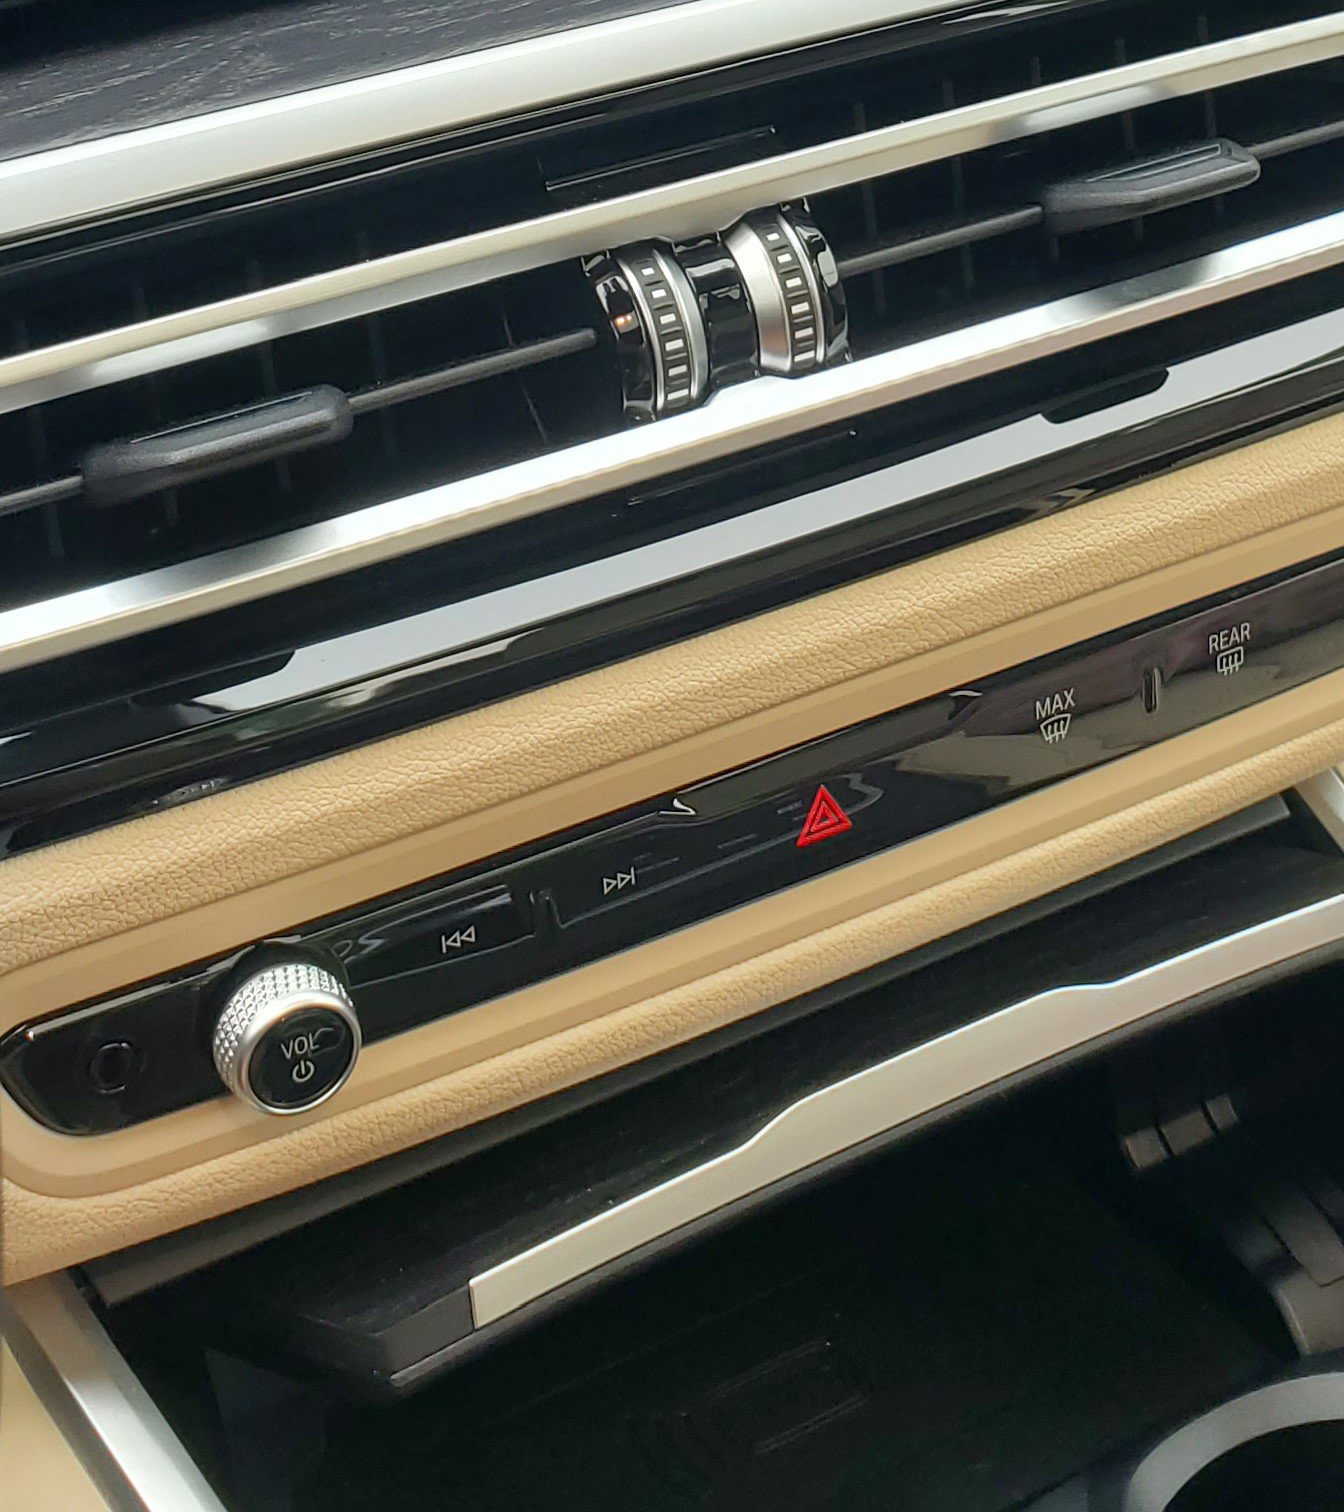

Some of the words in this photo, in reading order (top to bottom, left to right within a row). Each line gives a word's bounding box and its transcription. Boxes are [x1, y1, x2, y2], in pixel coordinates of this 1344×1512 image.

[1207, 621, 1251, 655] REAR
[1034, 687, 1076, 721] MAX
[280, 1032, 320, 1060] VOL
